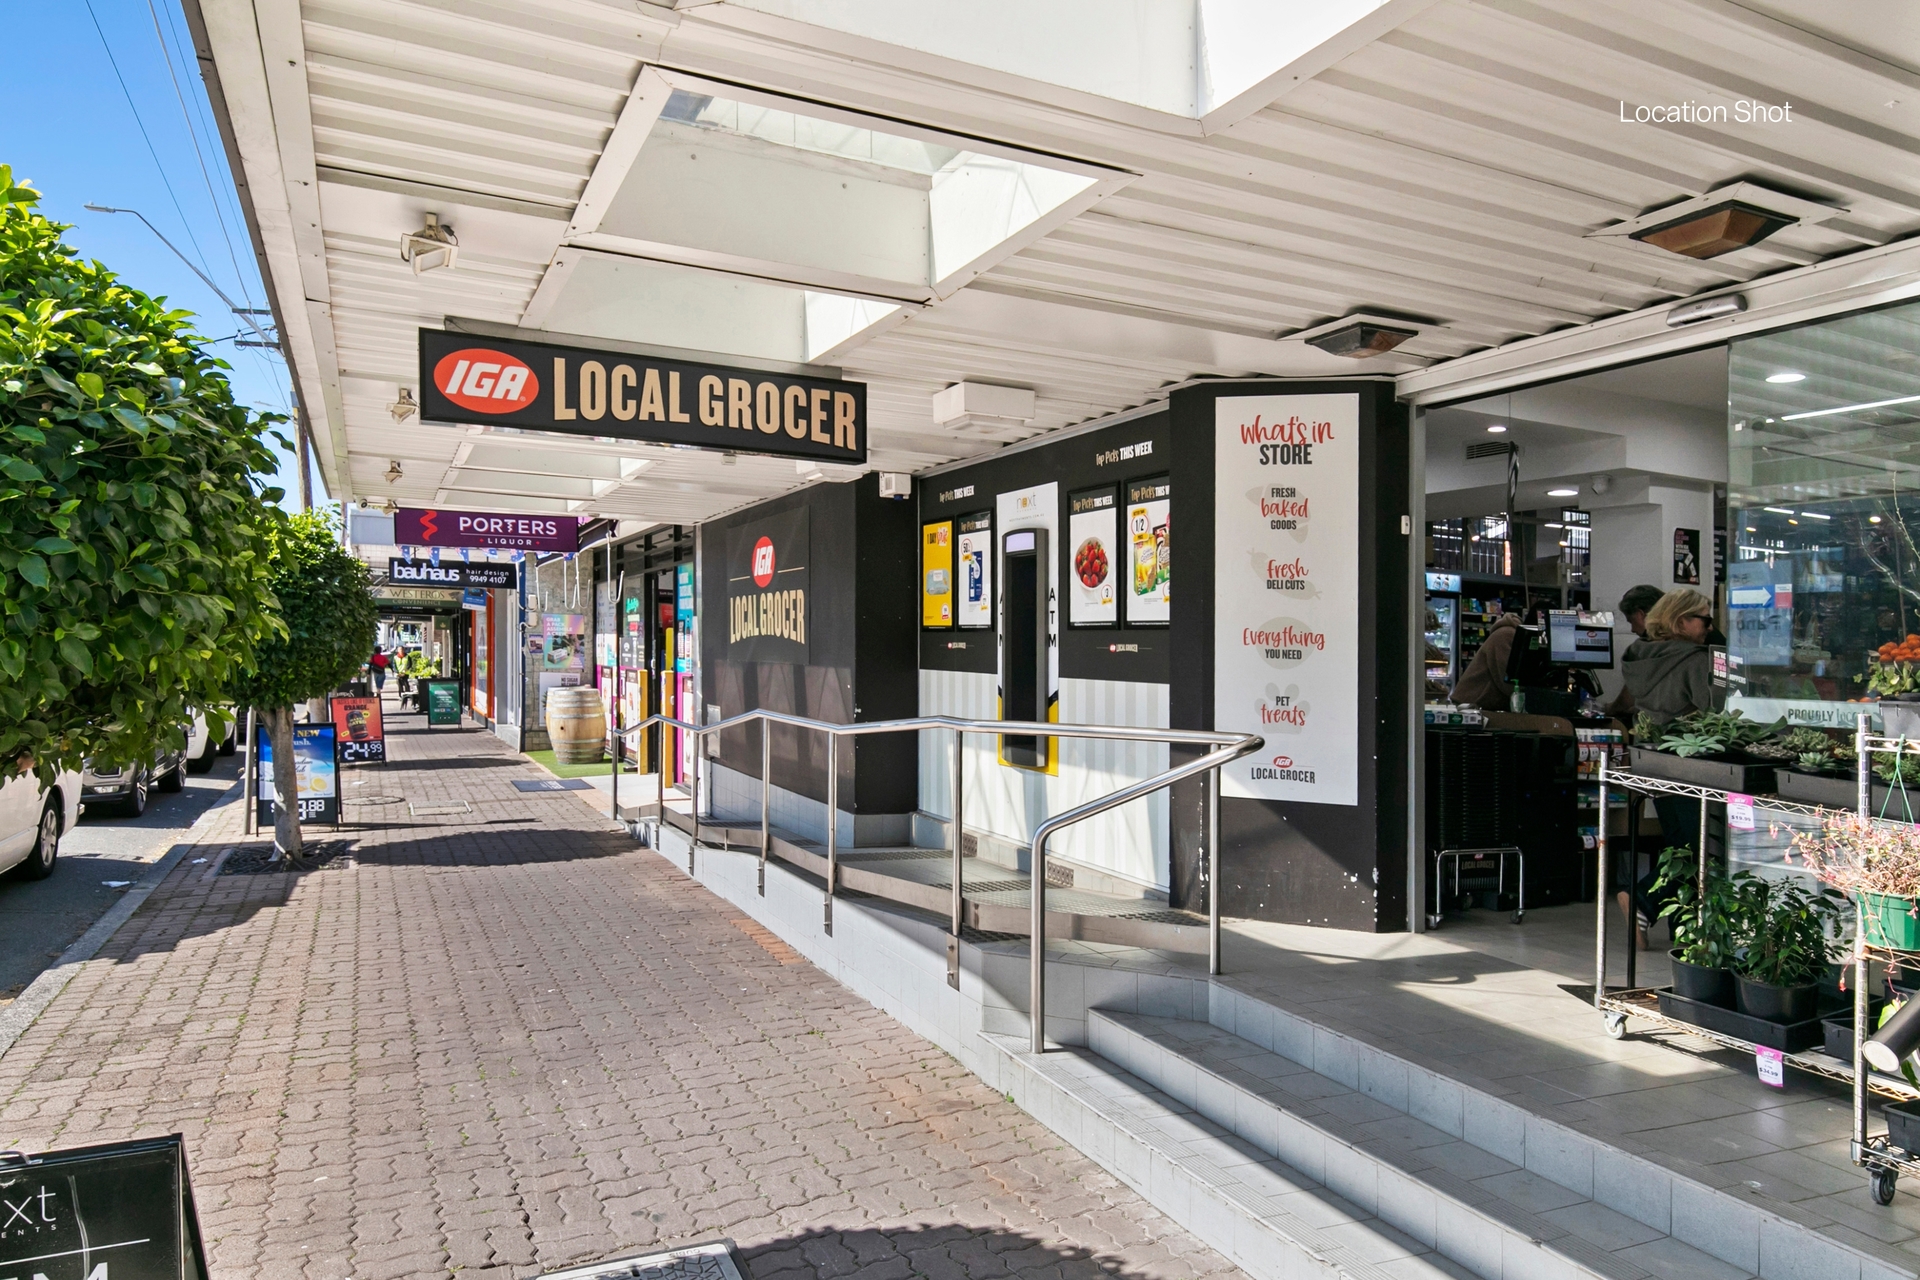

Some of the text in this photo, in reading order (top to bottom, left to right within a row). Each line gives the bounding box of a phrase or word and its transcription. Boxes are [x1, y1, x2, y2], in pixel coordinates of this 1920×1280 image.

[445, 360, 529, 400] IGA
[553, 357, 857, 451] LOCAL GROCER
[1240, 415, 1335, 446] what's in
[1095, 440, 1153, 466] Top Picks THIS WEEK
[1259, 443, 1313, 465] STORE
[1131, 489, 1139, 502] Top
[1141, 486, 1155, 500] Picks
[1155, 485, 1165, 497] THIS
[1271, 487, 1296, 498] FRESH
[1073, 495, 1113, 512] Top Picks THIS WEEK
[1260, 498, 1309, 519] baked
[459, 516, 558, 536] PORTERS
[1270, 519, 1297, 530] GOODS
[487, 537, 532, 546] LIQUOR
[754, 545, 774, 577] IGA
[393, 561, 460, 582] bauhaus
[469, 575, 507, 584] 9949 4107
[389, 588, 446, 599] WESTEROS
[1266, 579, 1305, 590] DELI CUTS
[730, 594, 760, 645] LOCAL
[760, 589, 805, 645] GROCER
[1243, 626, 1325, 650] Everything
[1265, 649, 1302, 660] YOU NEED
[1275, 696, 1290, 706] PET
[1261, 704, 1306, 726] treats
[297, 729, 320, 738] NEW
[1275, 757, 1291, 766] IGA
[1251, 767, 1316, 784] LOCAL GROCER
[4, 1185, 57, 1222] xt
